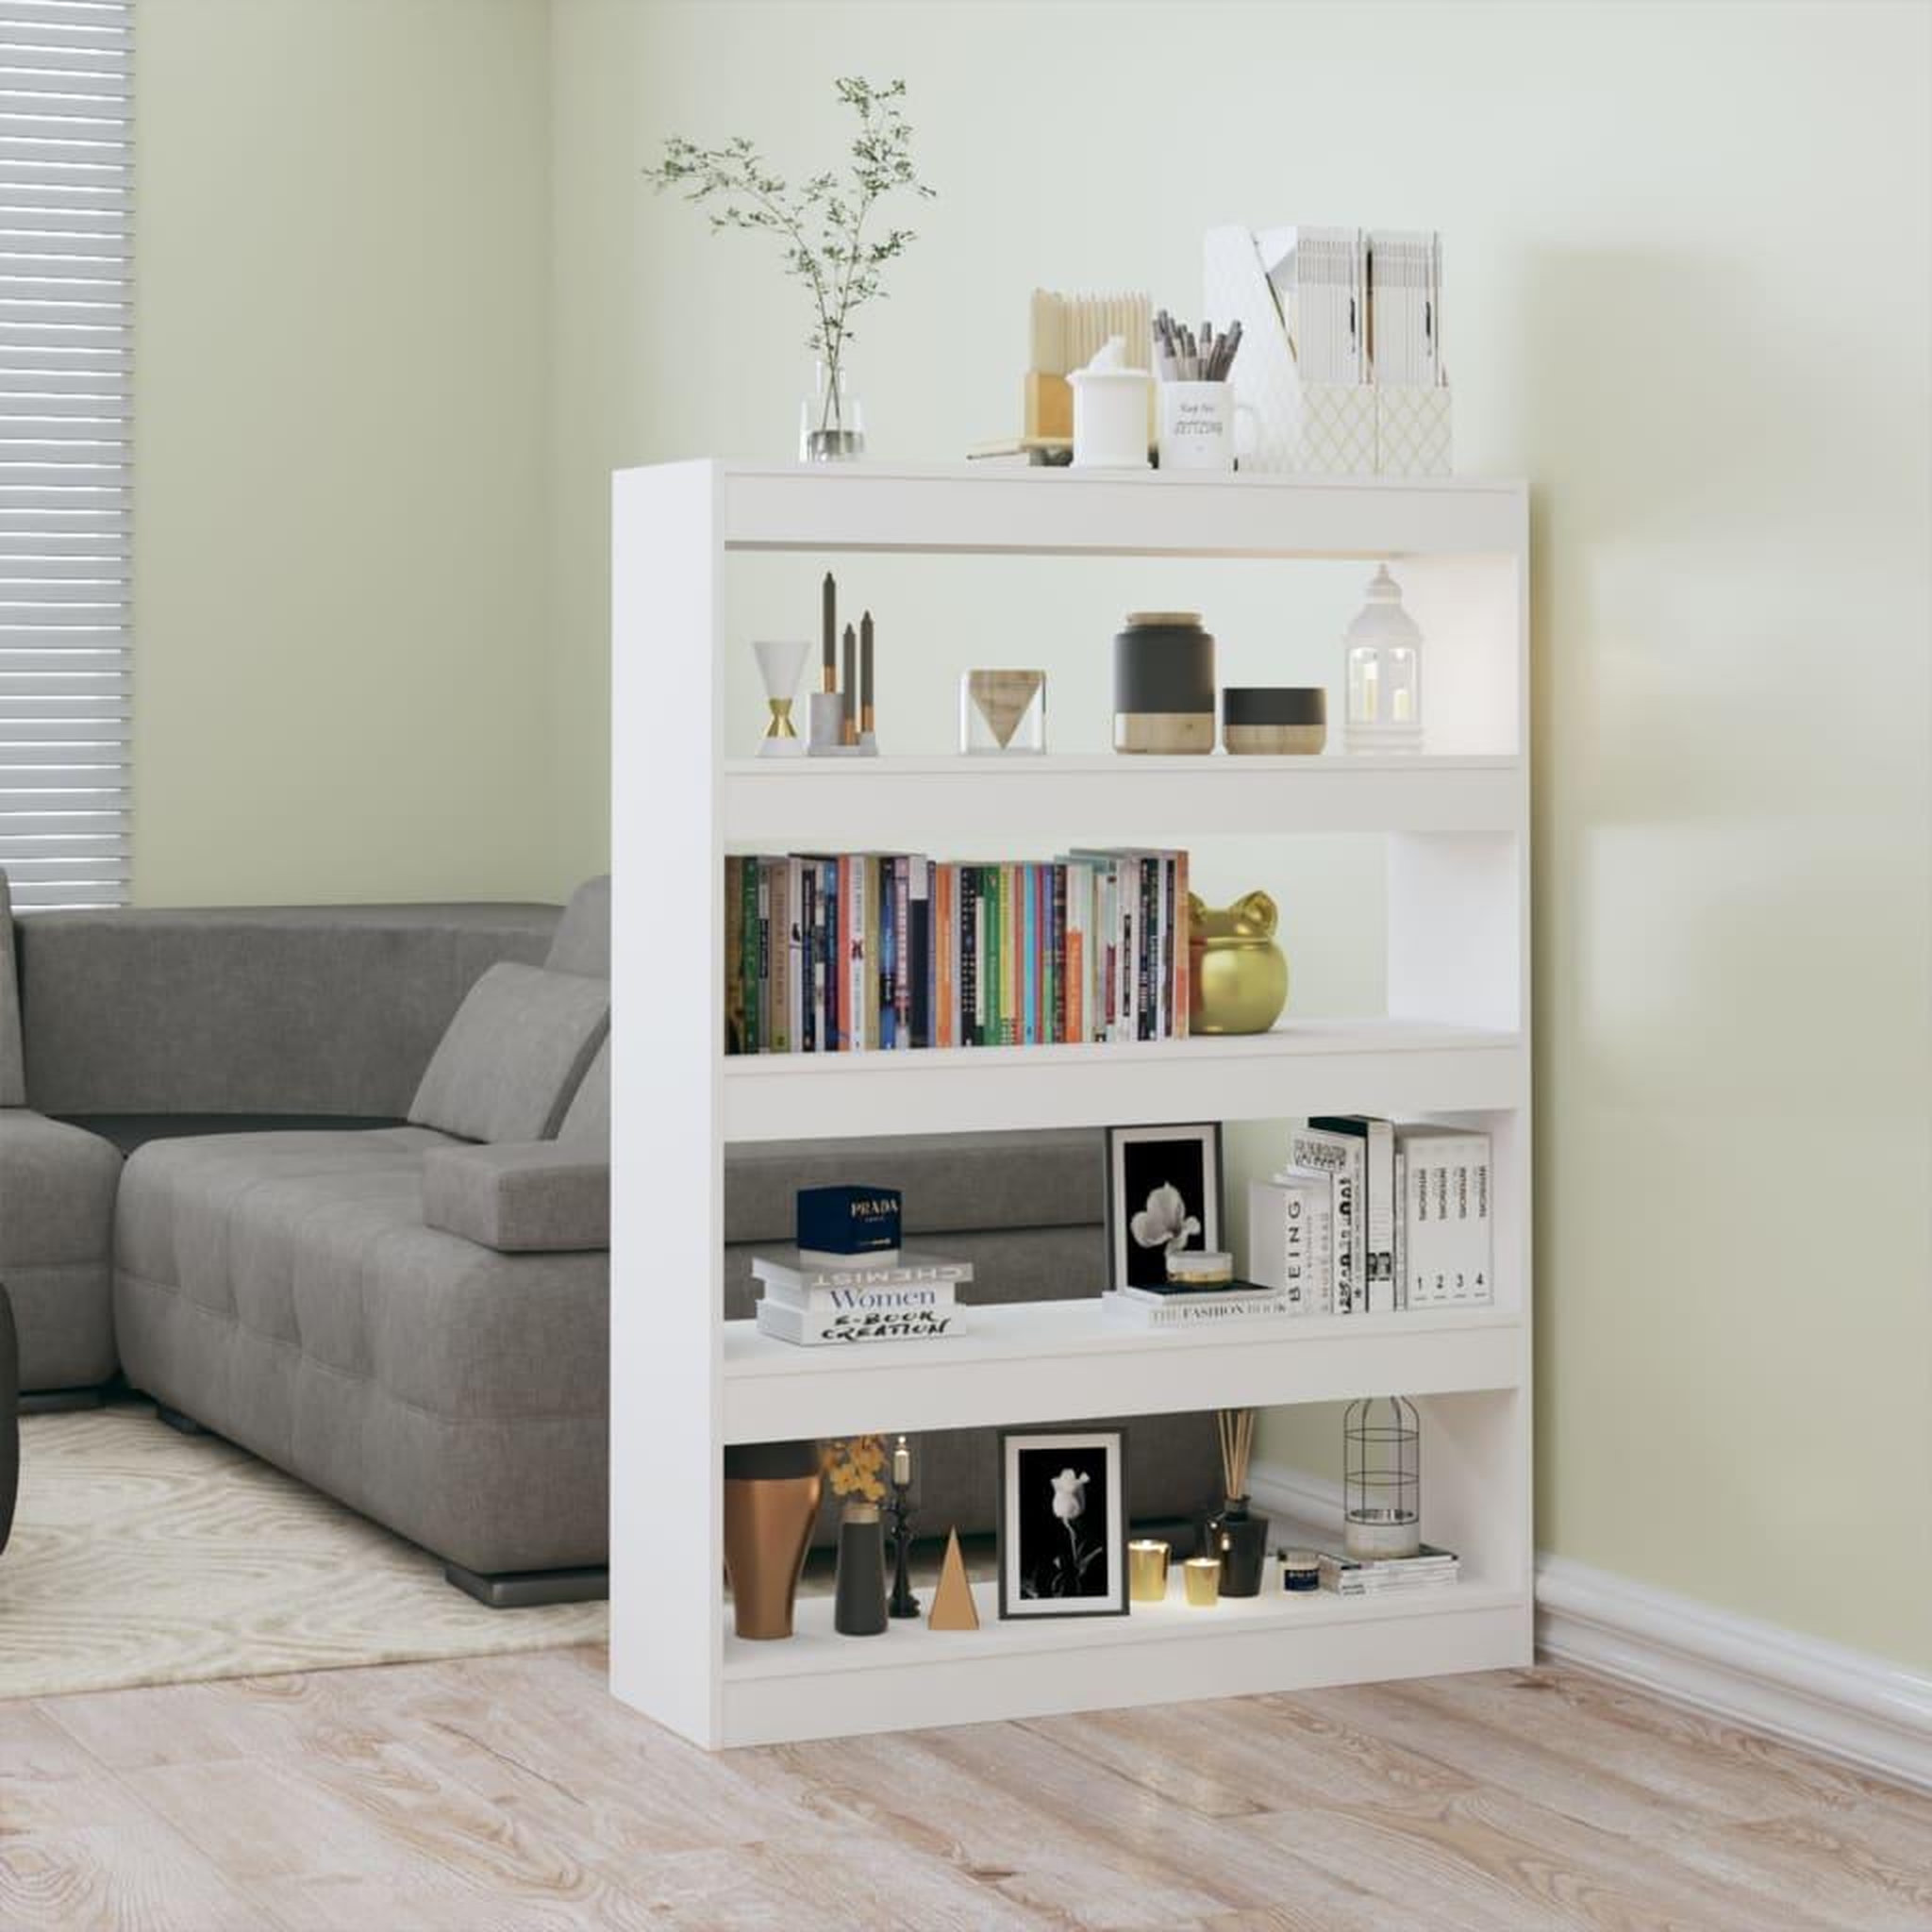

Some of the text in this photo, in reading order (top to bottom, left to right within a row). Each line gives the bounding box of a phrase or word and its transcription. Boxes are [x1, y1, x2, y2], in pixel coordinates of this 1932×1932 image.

[851, 1198, 898, 1218] PRADA
[1288, 1201, 1302, 1302] BEING
[830, 1289, 936, 1309] Women
[834, 1309, 937, 1326] E-BOOK
[1181, 1304, 1244, 1320] FASHION
[821, 1318, 952, 1341] CREATION
